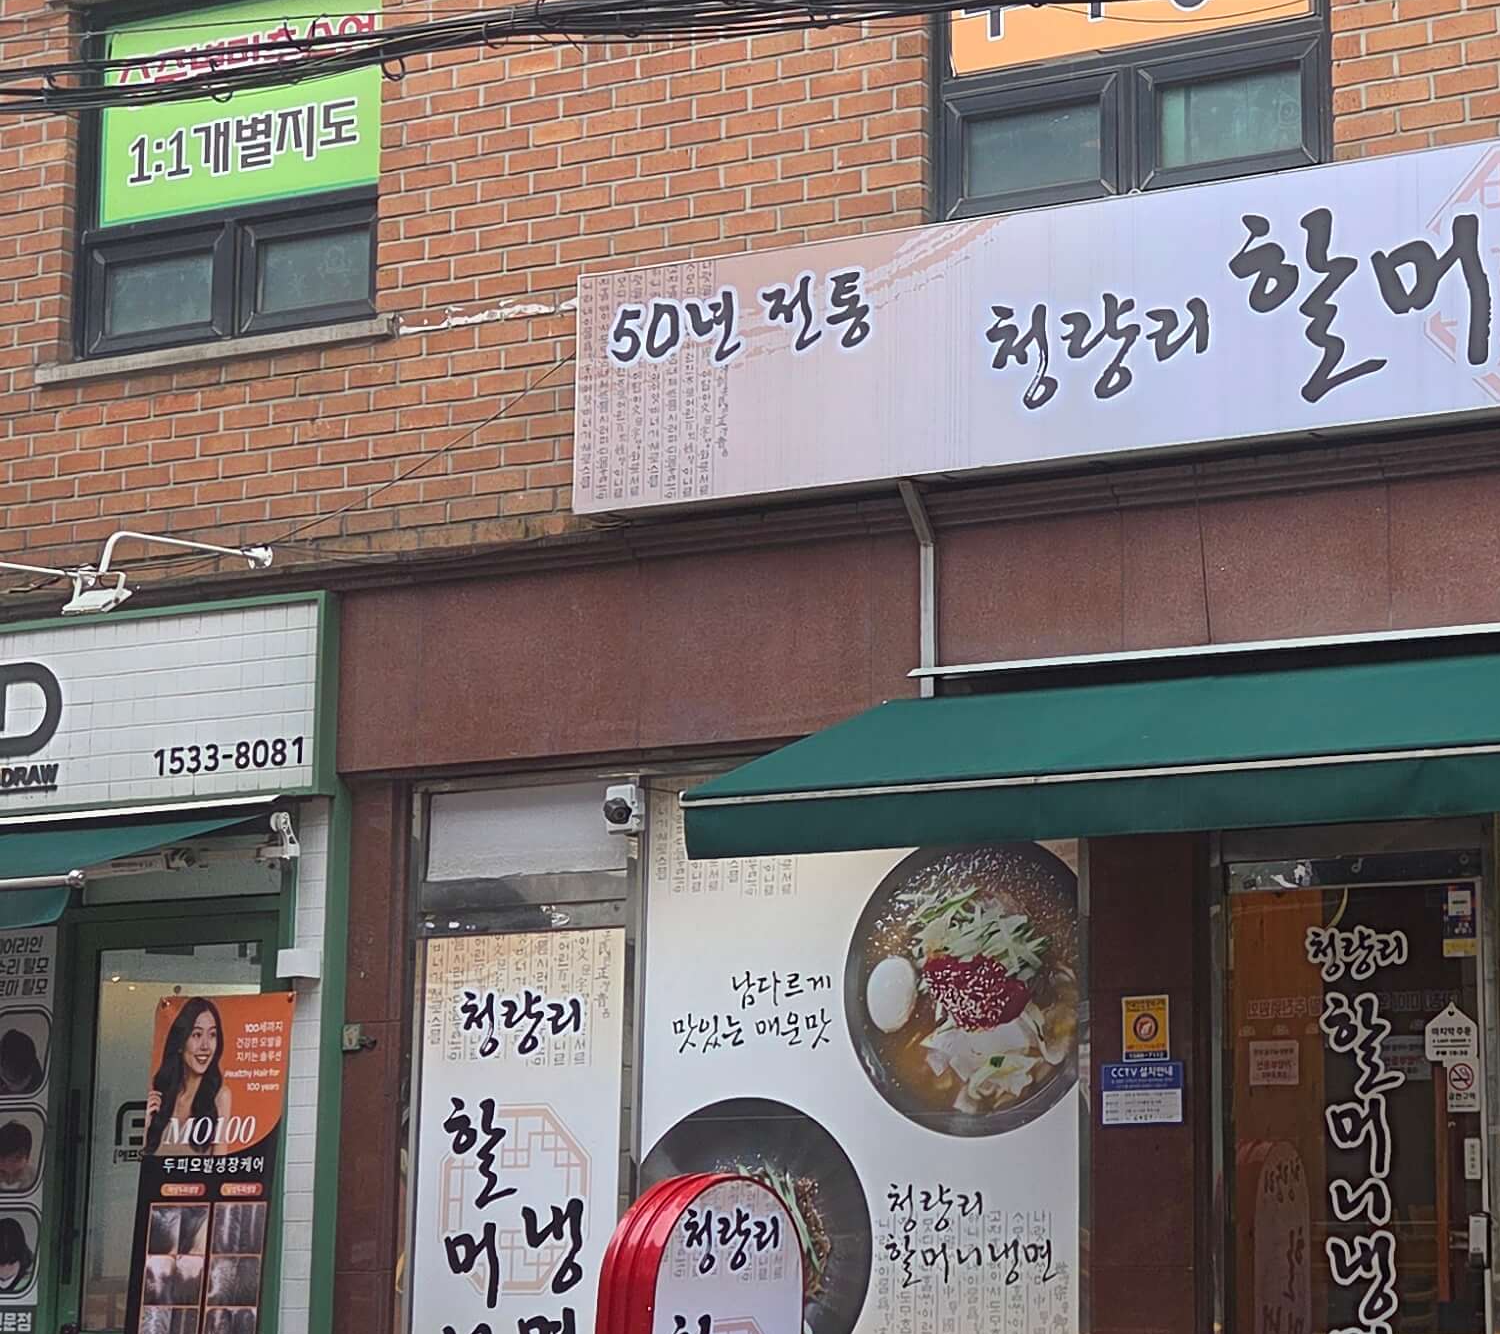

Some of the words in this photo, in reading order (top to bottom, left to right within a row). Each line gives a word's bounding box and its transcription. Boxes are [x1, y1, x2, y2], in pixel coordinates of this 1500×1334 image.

[611, 291, 741, 363] 50년
[761, 270, 870, 352] 전통
[986, 293, 1210, 409] 청량리
[154, 736, 304, 777] 1533-8081
[1307, 928, 1406, 980] 청량리
[732, 970, 832, 1010] 남다르게
[460, 990, 582, 1058] 청량리
[672, 1012, 745, 1054] 맛있는
[755, 1008, 832, 1049] 매운맛
[1111, 1067, 1138, 1078] CCTV
[164, 1115, 256, 1145] MO100
[887, 1183, 984, 1233] 청량리
[683, 1207, 781, 1276] 청량리
[884, 1233, 1058, 1289] 할머니냉면
